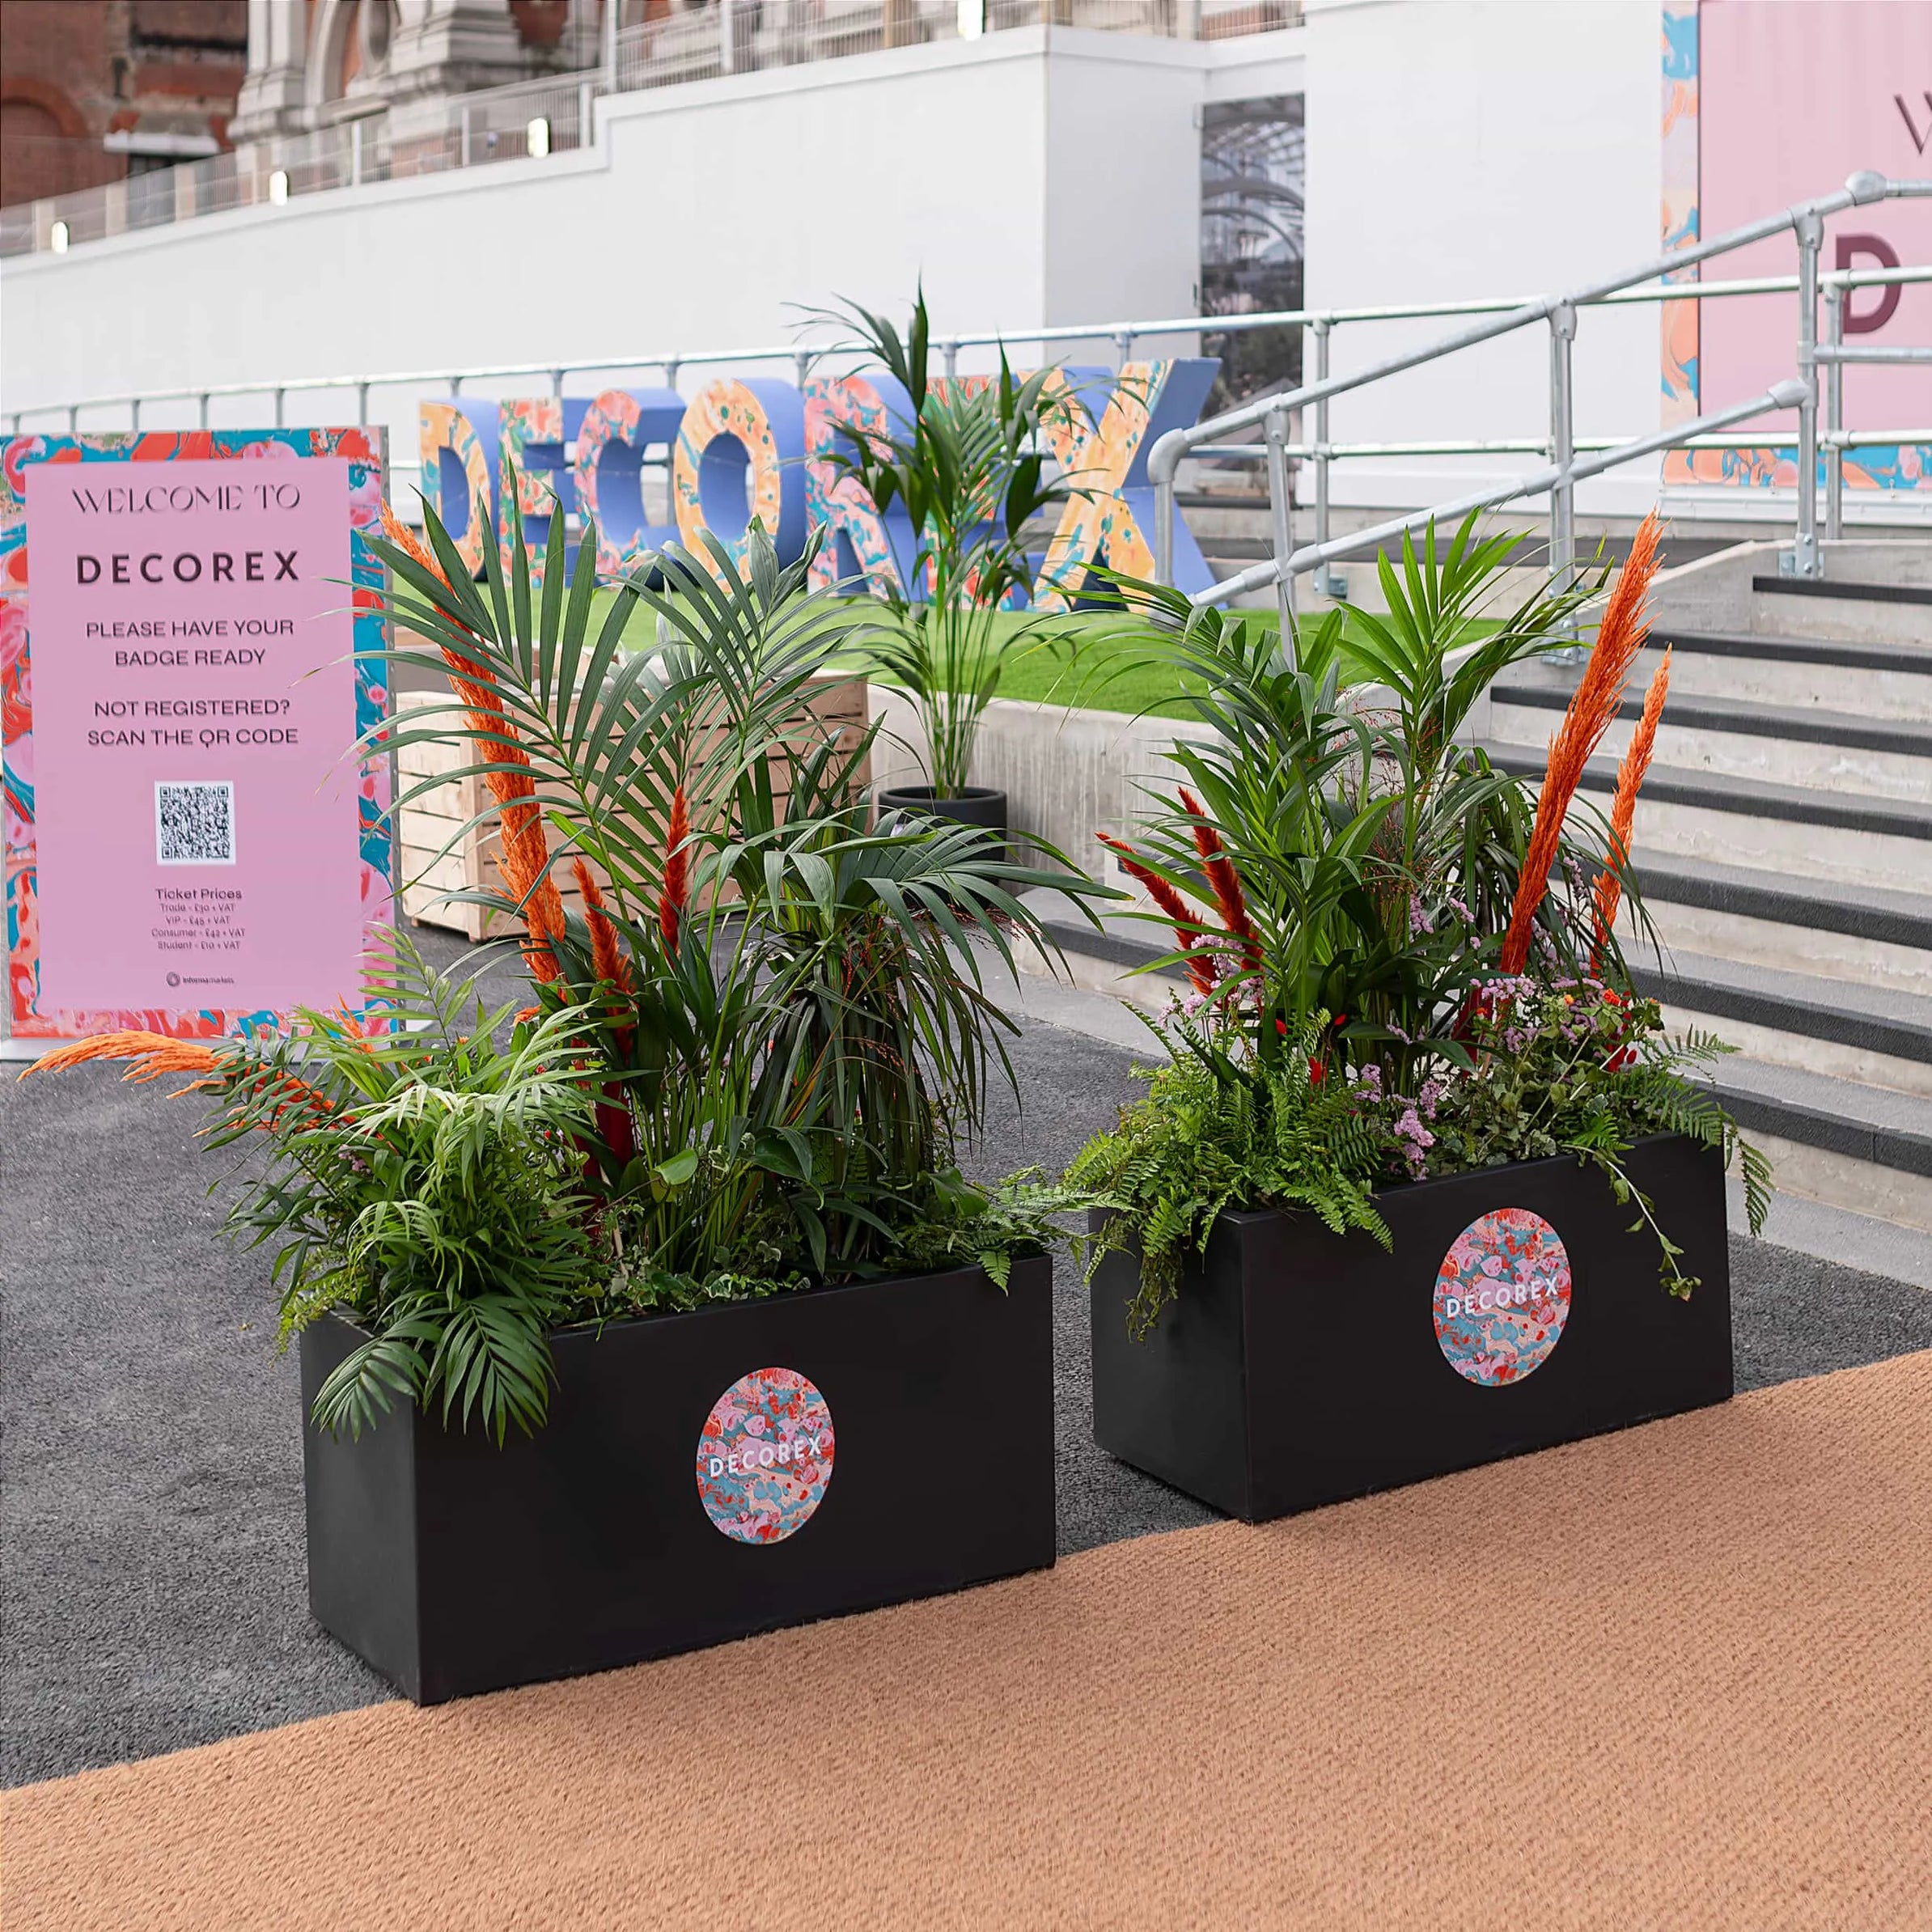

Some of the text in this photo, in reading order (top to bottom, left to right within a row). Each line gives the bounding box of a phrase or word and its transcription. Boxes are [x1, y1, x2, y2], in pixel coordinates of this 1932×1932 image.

[72, 484, 300, 514] WELCOME TO
[76, 551, 299, 585] DECOREX
[87, 619, 294, 638] PLEASE HAVE YOUR
[115, 649, 265, 667] BADGE READY
[95, 699, 290, 717] NOT REGISTERED?
[88, 728, 299, 748] SCAN THE QR CODE
[155, 888, 242, 900] Ticket Prices
[160, 903, 186, 912] Trade
[218, 903, 235, 912] VAT
[165, 916, 181, 924] VIP
[213, 915, 231, 924] VAT
[151, 928, 197, 937] Consumer
[228, 928, 245, 937] VAT
[157, 941, 192, 950] Student
[222, 940, 240, 949] VAT
[1446, 1276, 1558, 1319] DECOREX
[710, 1435, 822, 1477] DECOREX
